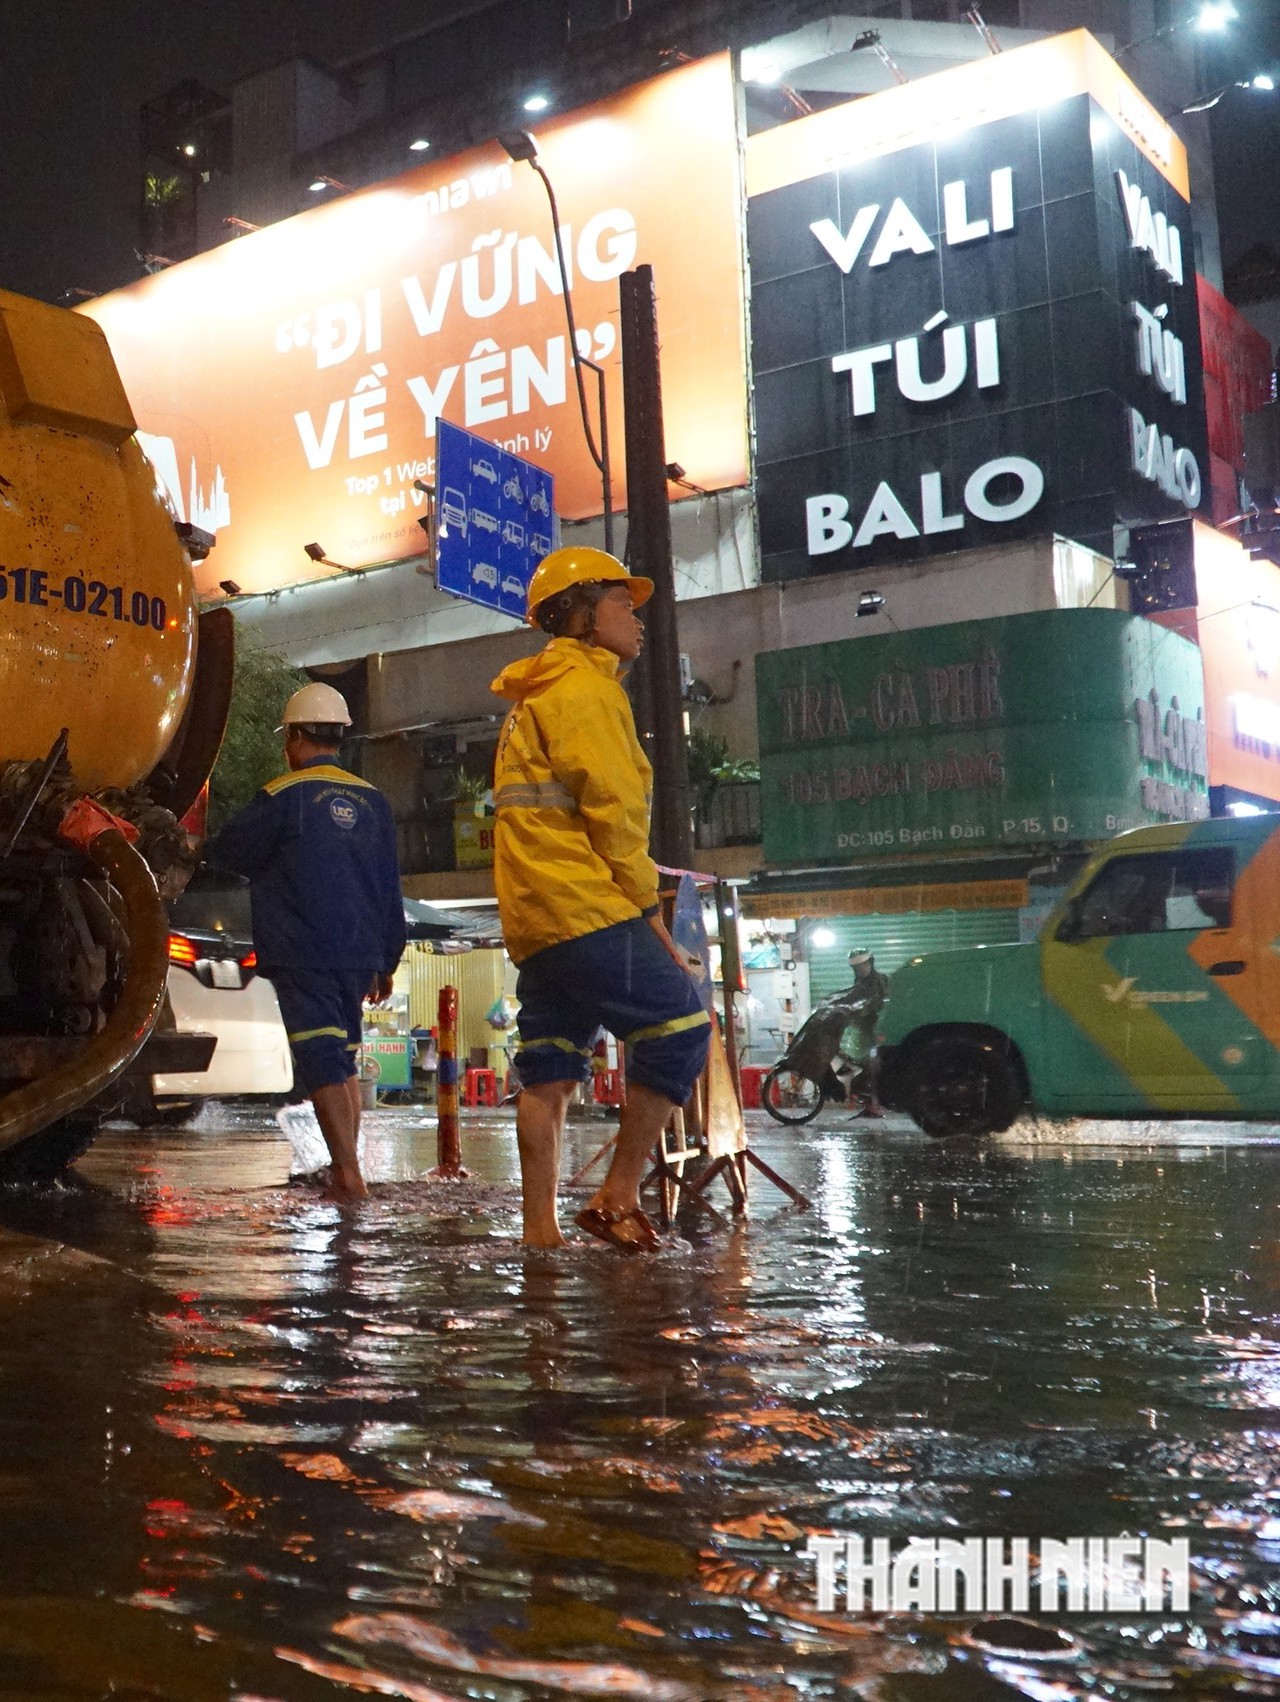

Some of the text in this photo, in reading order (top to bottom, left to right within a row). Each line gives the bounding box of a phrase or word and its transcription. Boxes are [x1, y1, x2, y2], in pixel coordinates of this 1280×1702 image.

[810, 166, 1015, 274] VALI
[401, 208, 638, 337] VỮNG
[832, 310, 1001, 417] TÚI
[1132, 301, 1188, 406] TÚI
[293, 362, 388, 470] VỀ
[345, 473, 379, 496] Top
[383, 466, 393, 486] 1
[534, 426, 553, 453] lý
[1131, 407, 1202, 510] BALO
[806, 456, 1045, 556] BALO
[925, 648, 1004, 725] PHÊ
[899, 826, 943, 846] Bạch
